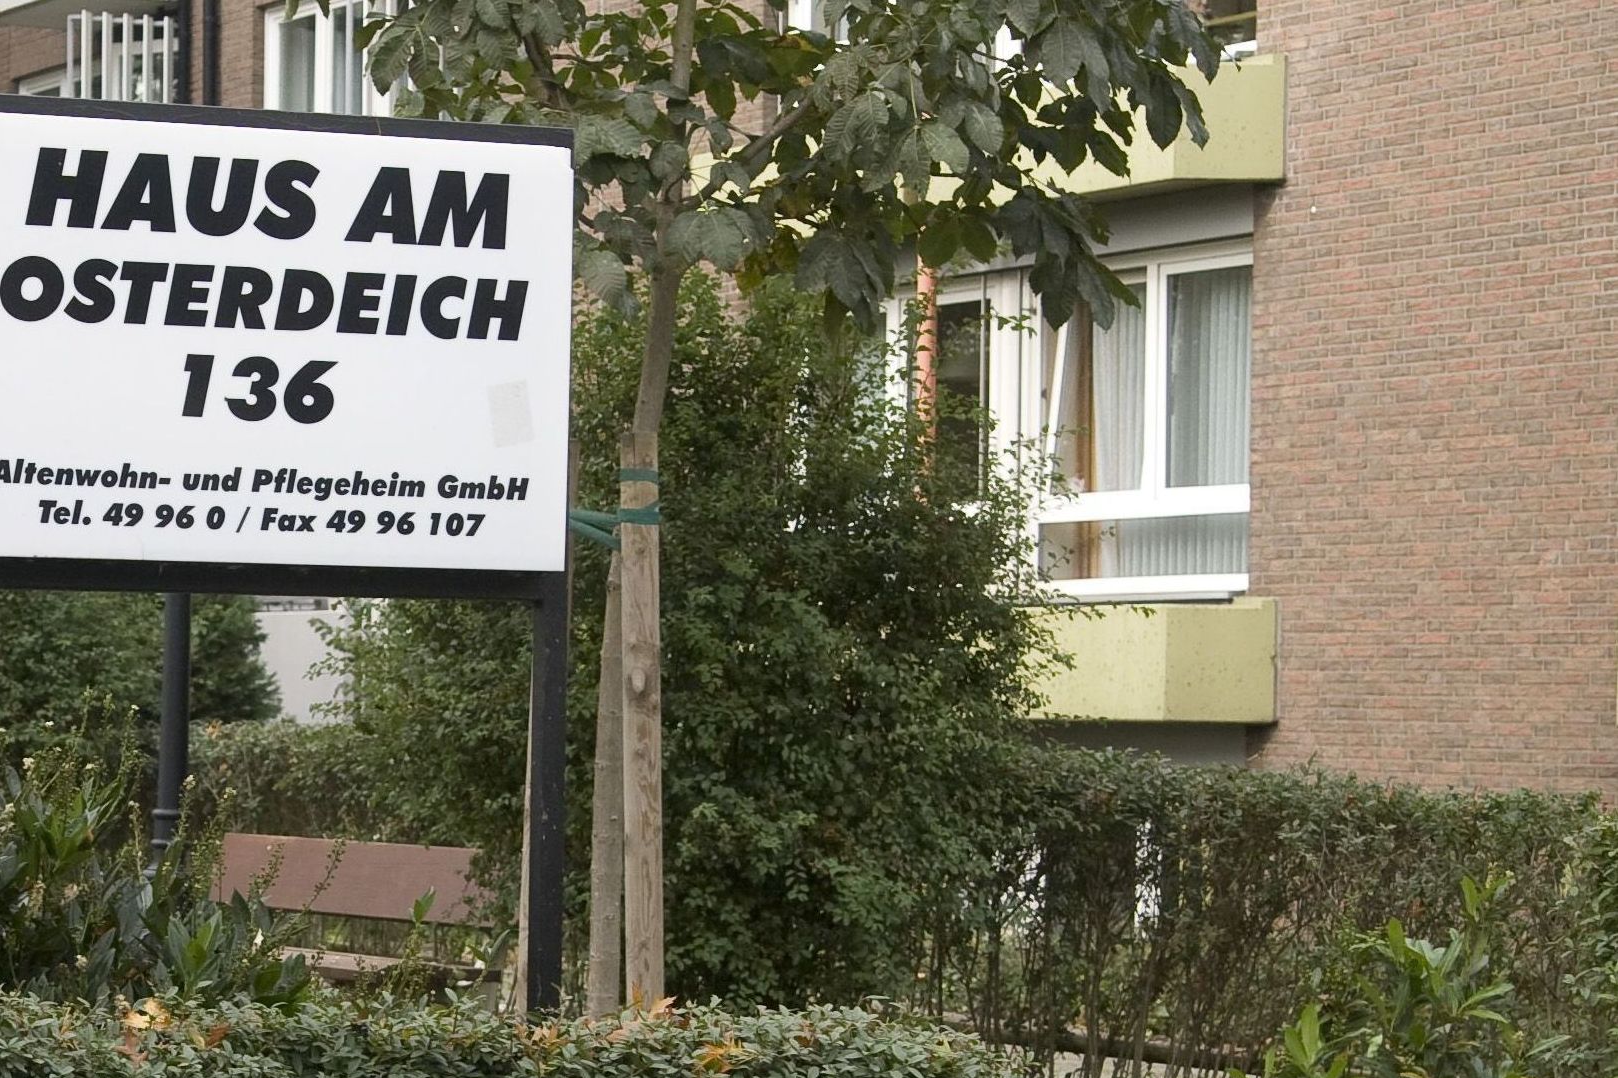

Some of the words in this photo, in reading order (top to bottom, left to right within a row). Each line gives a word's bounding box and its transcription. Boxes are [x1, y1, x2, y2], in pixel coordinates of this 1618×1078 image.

[25, 147, 320, 239] HAUS
[345, 166, 510, 250] AM
[0, 256, 529, 341] OSTERDEICH
[181, 354, 339, 425] 136
[38, 499, 92, 525] Tel.
[102, 502, 144, 526] 49
[154, 504, 195, 529] 96
[206, 505, 226, 530] 0
[235, 507, 250, 533] /
[260, 507, 317, 532] Fax
[325, 509, 366, 533] 49
[376, 510, 416, 535] 96
[429, 512, 486, 536] 107
[182, 467, 242, 491] und
[251, 468, 425, 501] Pflegeheim
[437, 475, 529, 501] GmbH
